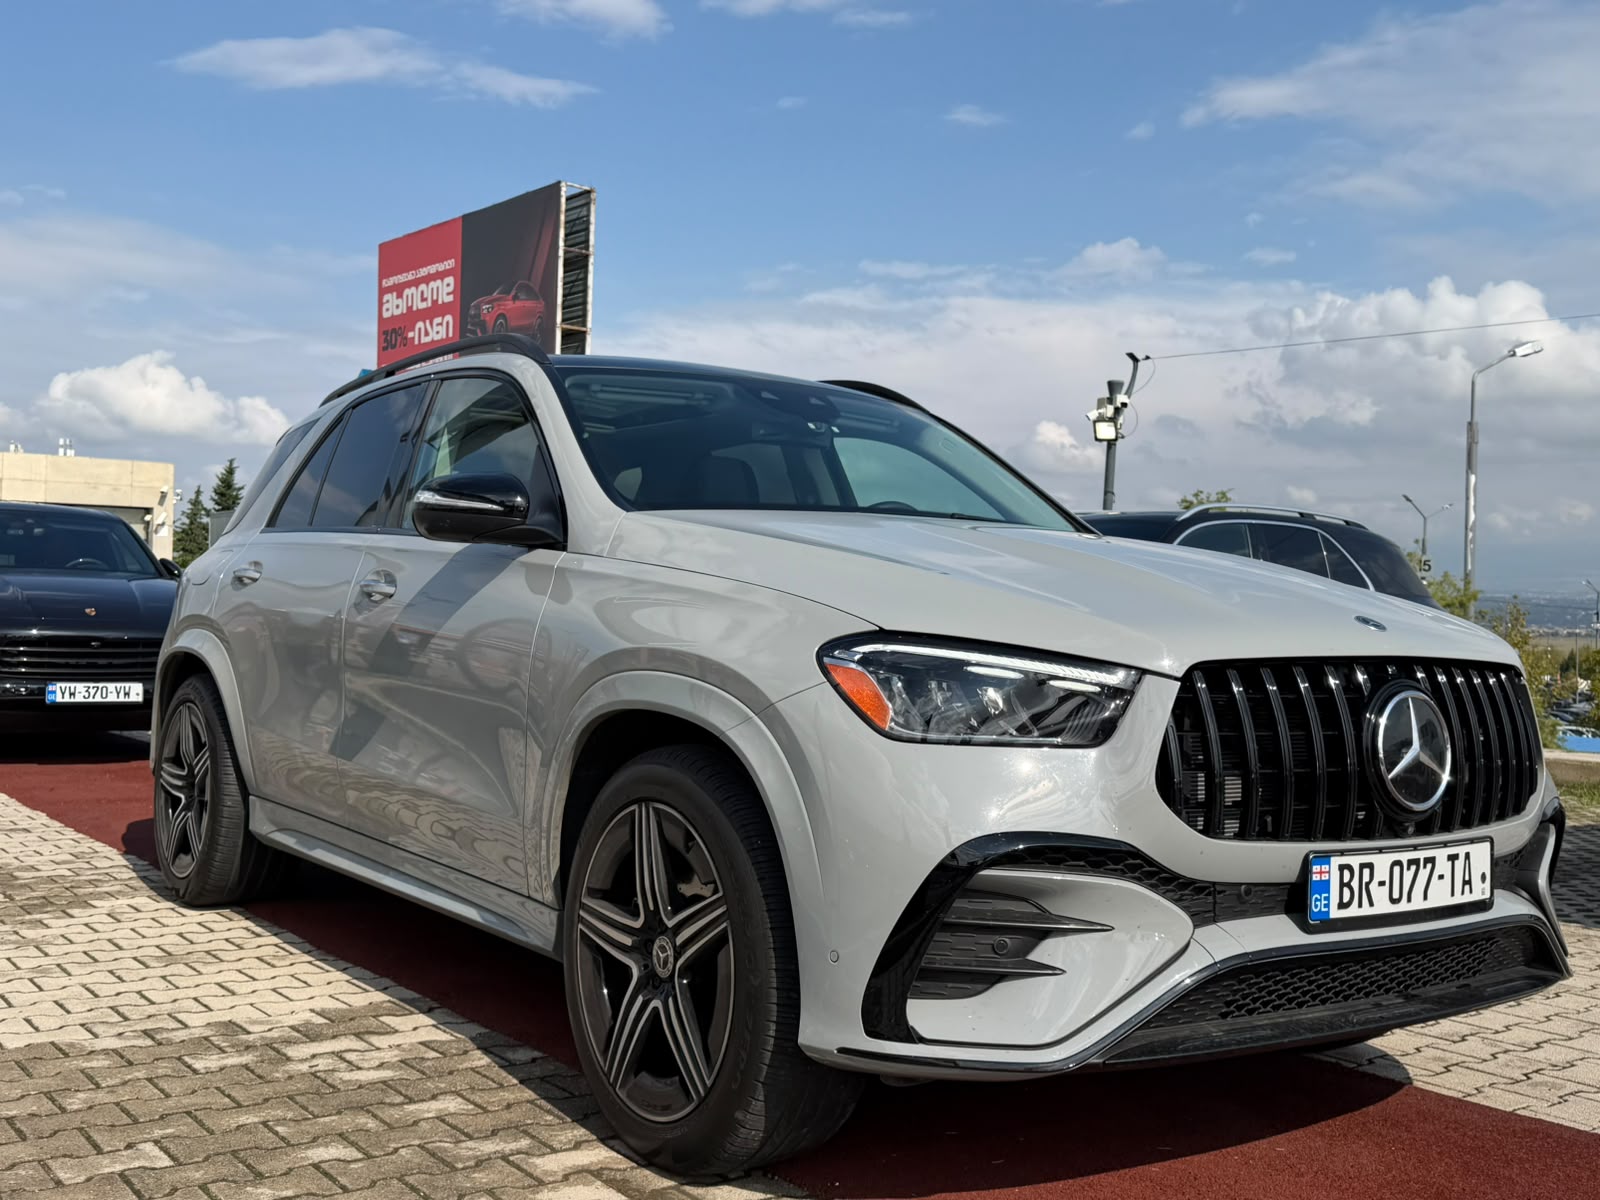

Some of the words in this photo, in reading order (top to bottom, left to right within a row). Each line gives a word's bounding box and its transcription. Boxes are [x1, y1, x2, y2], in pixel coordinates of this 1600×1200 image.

[382, 275, 455, 319] მხოლოდ
[382, 314, 453, 352] 30%-იანი
[59, 685, 131, 700] YW-370-YW
[1311, 893, 1329, 912] GE
[1337, 851, 1473, 910] BR-077-TA
